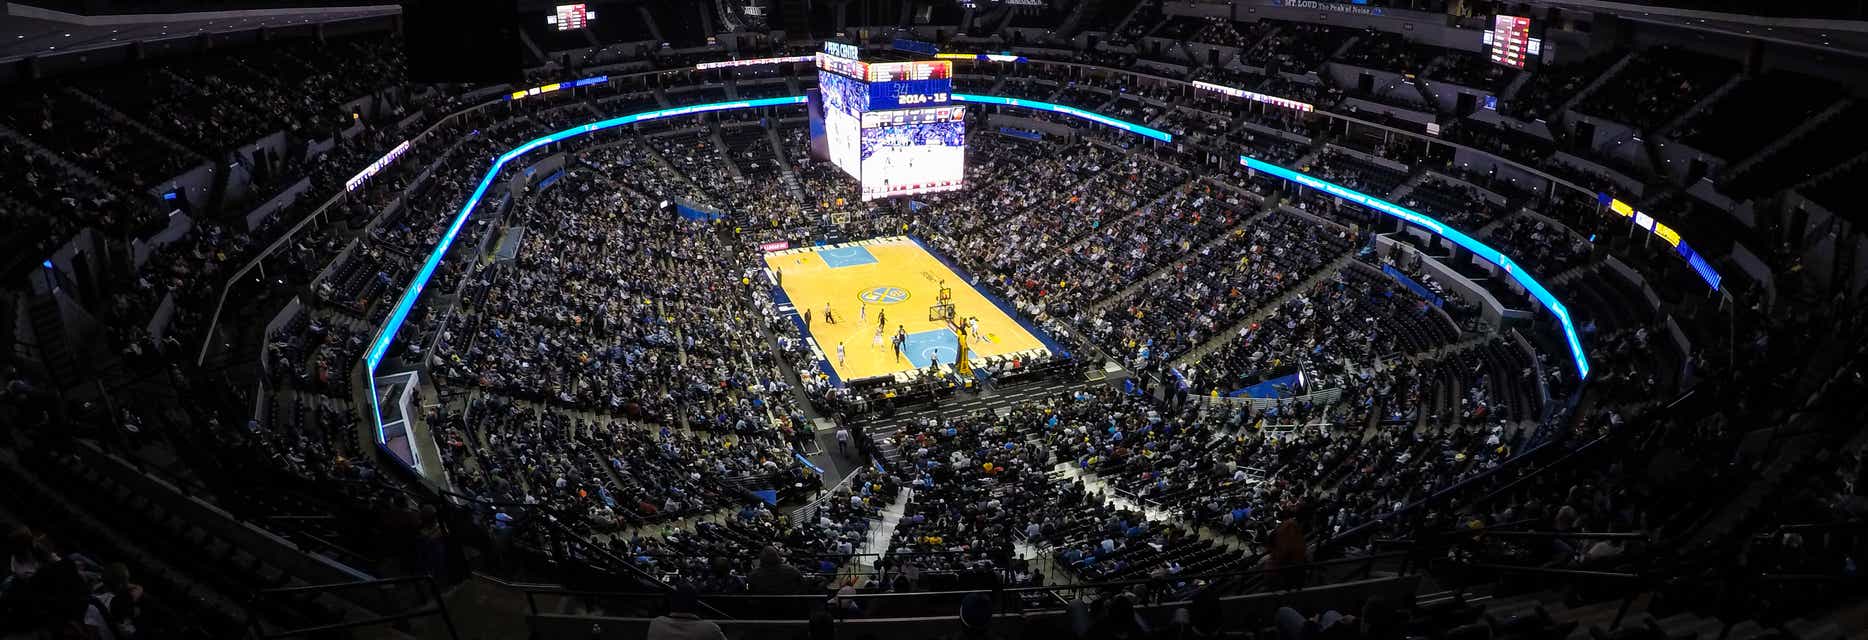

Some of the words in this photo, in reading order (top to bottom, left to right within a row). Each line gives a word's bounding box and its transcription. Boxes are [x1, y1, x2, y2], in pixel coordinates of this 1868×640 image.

[1298, 0, 1318, 9] LOUD
[828, 41, 840, 56] PEPSI
[840, 43, 858, 60] CENTER
